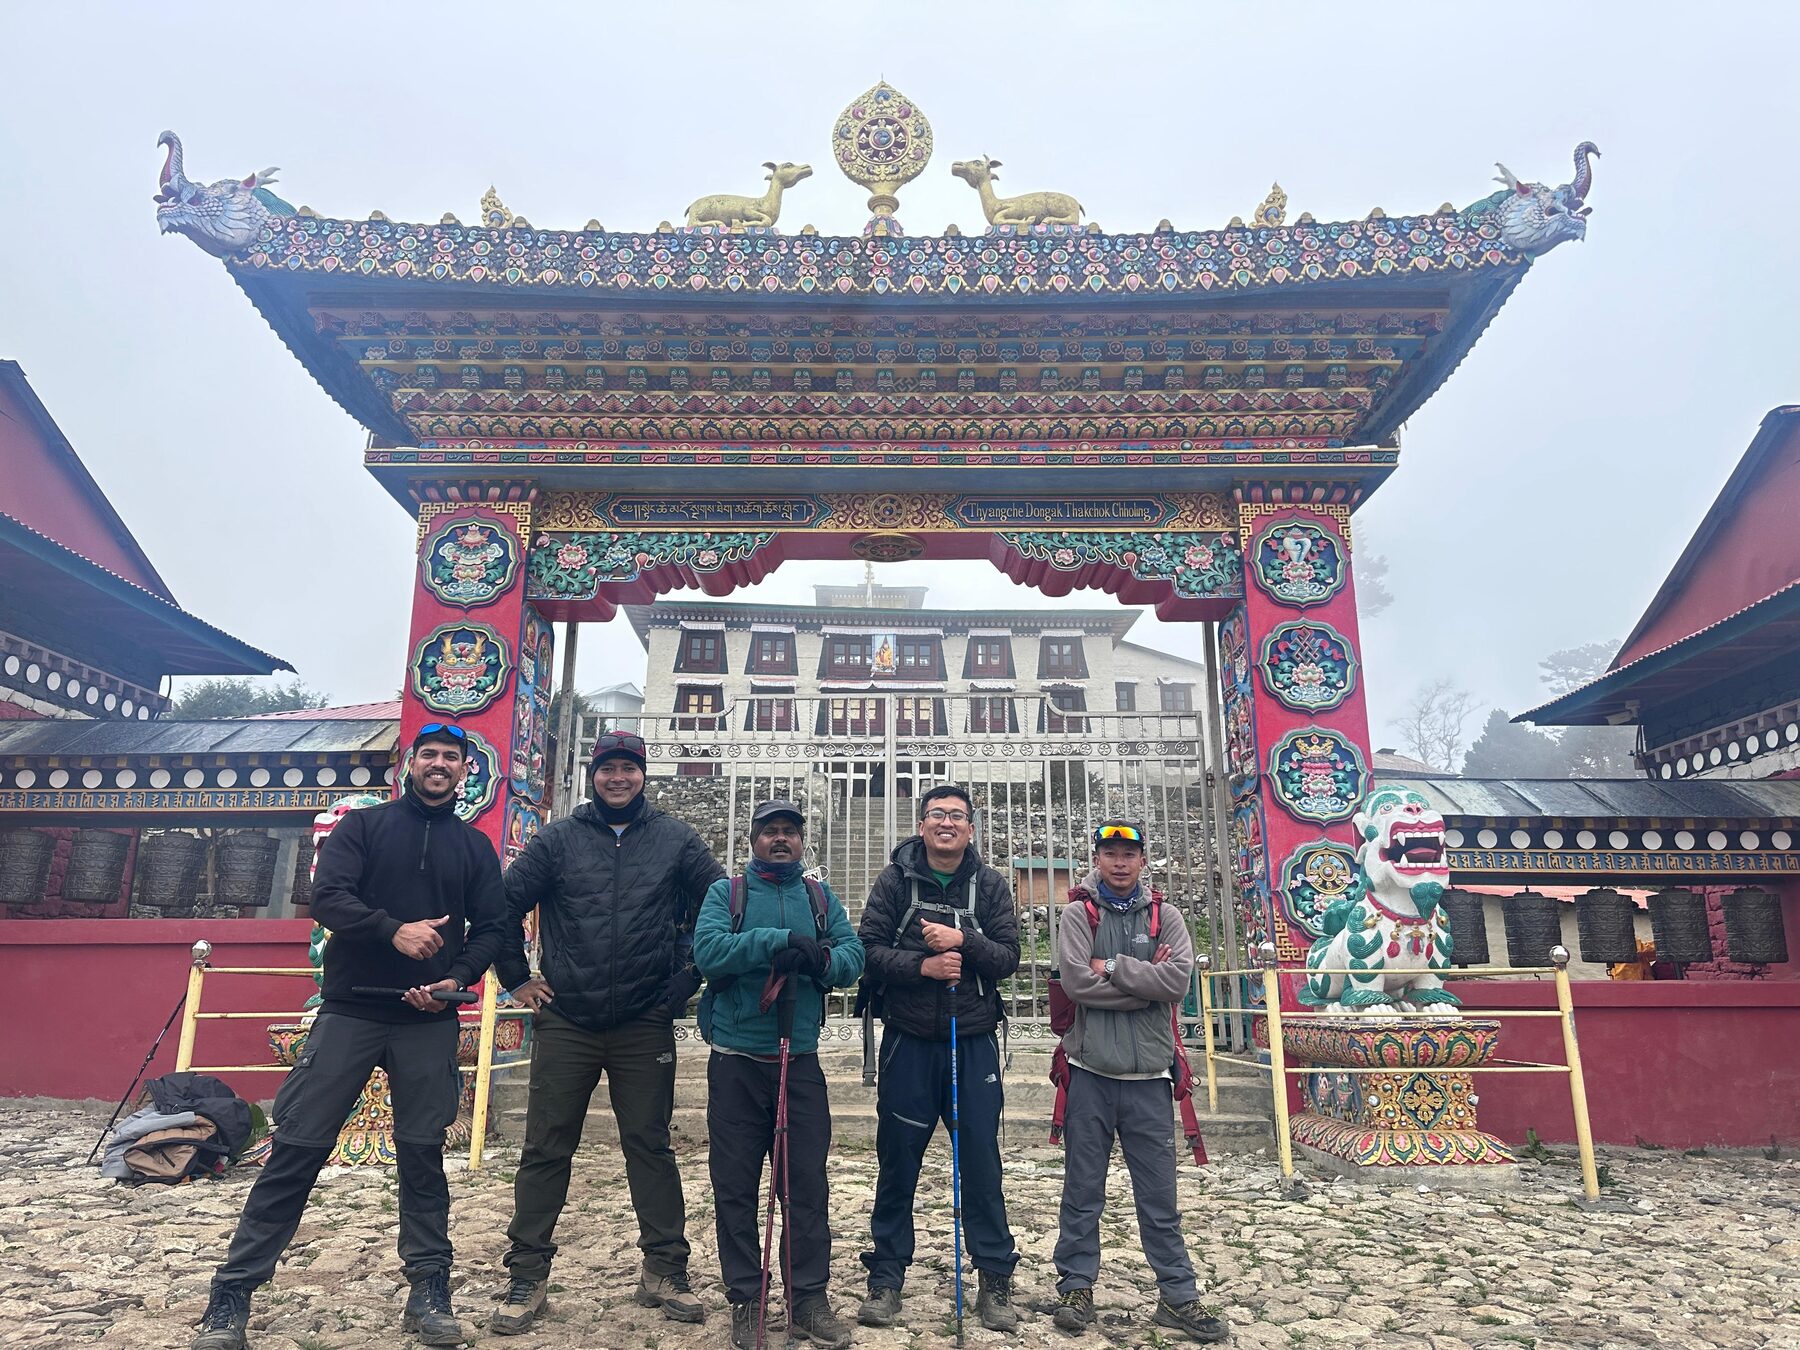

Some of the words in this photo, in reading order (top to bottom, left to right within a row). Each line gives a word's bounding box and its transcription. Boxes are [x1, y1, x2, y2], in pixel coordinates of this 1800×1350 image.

[968, 502, 1024, 521] Thyangche
[1025, 503, 1063, 522] Dongak
[1065, 502, 1111, 518] Thakchok
[1111, 503, 1150, 522] Chholing
